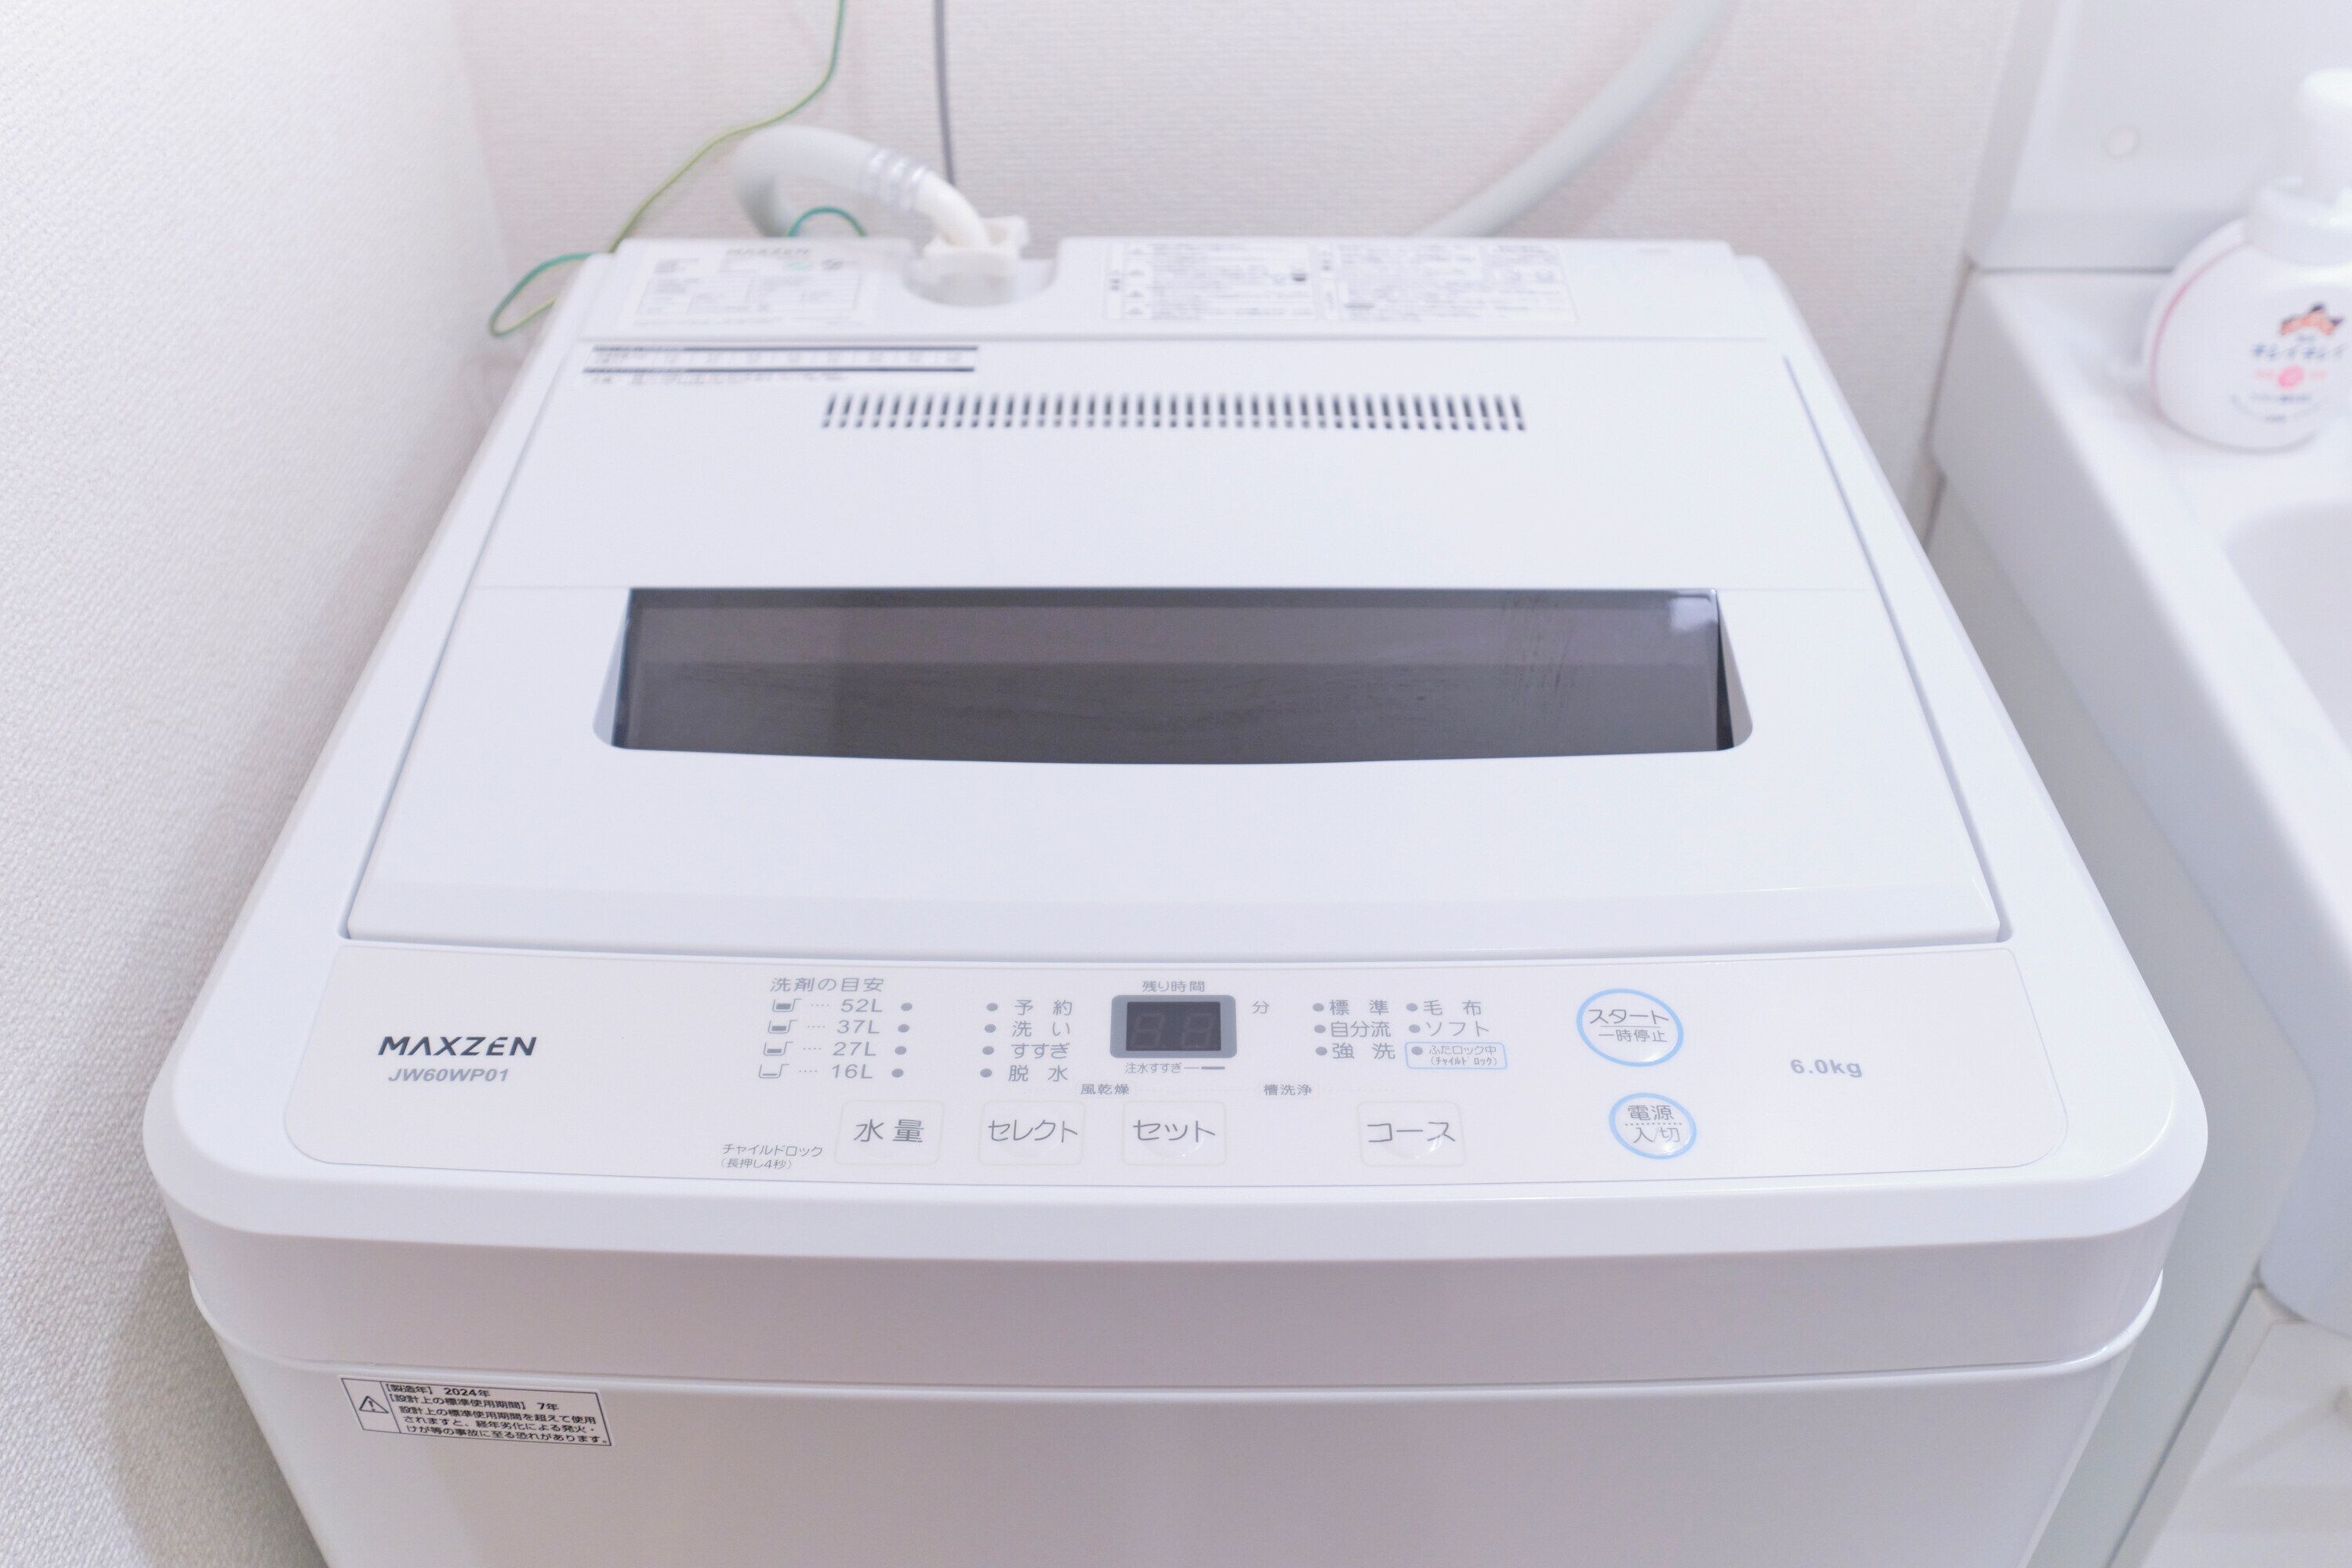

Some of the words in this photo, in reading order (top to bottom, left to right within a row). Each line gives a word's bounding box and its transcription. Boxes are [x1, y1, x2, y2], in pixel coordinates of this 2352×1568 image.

[770, 977, 884, 993] 洗剤の目安
[1142, 980, 1205, 993] 残り時間
[840, 999, 884, 1013] 52L
[1014, 1000, 1073, 1016] 予約
[1252, 1000, 1270, 1014] 分
[1329, 1000, 1389, 1015] 標準
[1423, 1000, 1483, 1015] 毛布
[1588, 1008, 1669, 1024] スタート
[837, 1020, 880, 1034] 37L
[1011, 1021, 1070, 1037] 洗い
[1330, 1021, 1392, 1038] 自分流
[1425, 1021, 1490, 1036] ソフト
[1598, 1029, 1668, 1044] 一時停止
[377, 1036, 537, 1056] MAXZEN
[833, 1042, 877, 1056] 27L
[1012, 1043, 1070, 1059] すすぎ
[1333, 1042, 1396, 1060] 強洗
[1428, 1045, 1497, 1055] ふたロック中
[387, 1069, 509, 1082] JW60WP01
[831, 1064, 873, 1079] 16L
[1008, 1065, 1069, 1083] 脱水
[1125, 1062, 1182, 1074] 注水すすぎ
[1790, 1058, 1863, 1078] 6.0kg
[1080, 1083, 1130, 1096] 風乾燥
[1263, 1083, 1312, 1096] 槽洗浄
[1627, 1105, 1675, 1121] 電源
[853, 1118, 924, 1143] 水量
[987, 1120, 1078, 1143] セレクト
[1133, 1119, 1216, 1142] セット
[1367, 1120, 1456, 1143] コース
[722, 1143, 823, 1158] チャイルドロック
